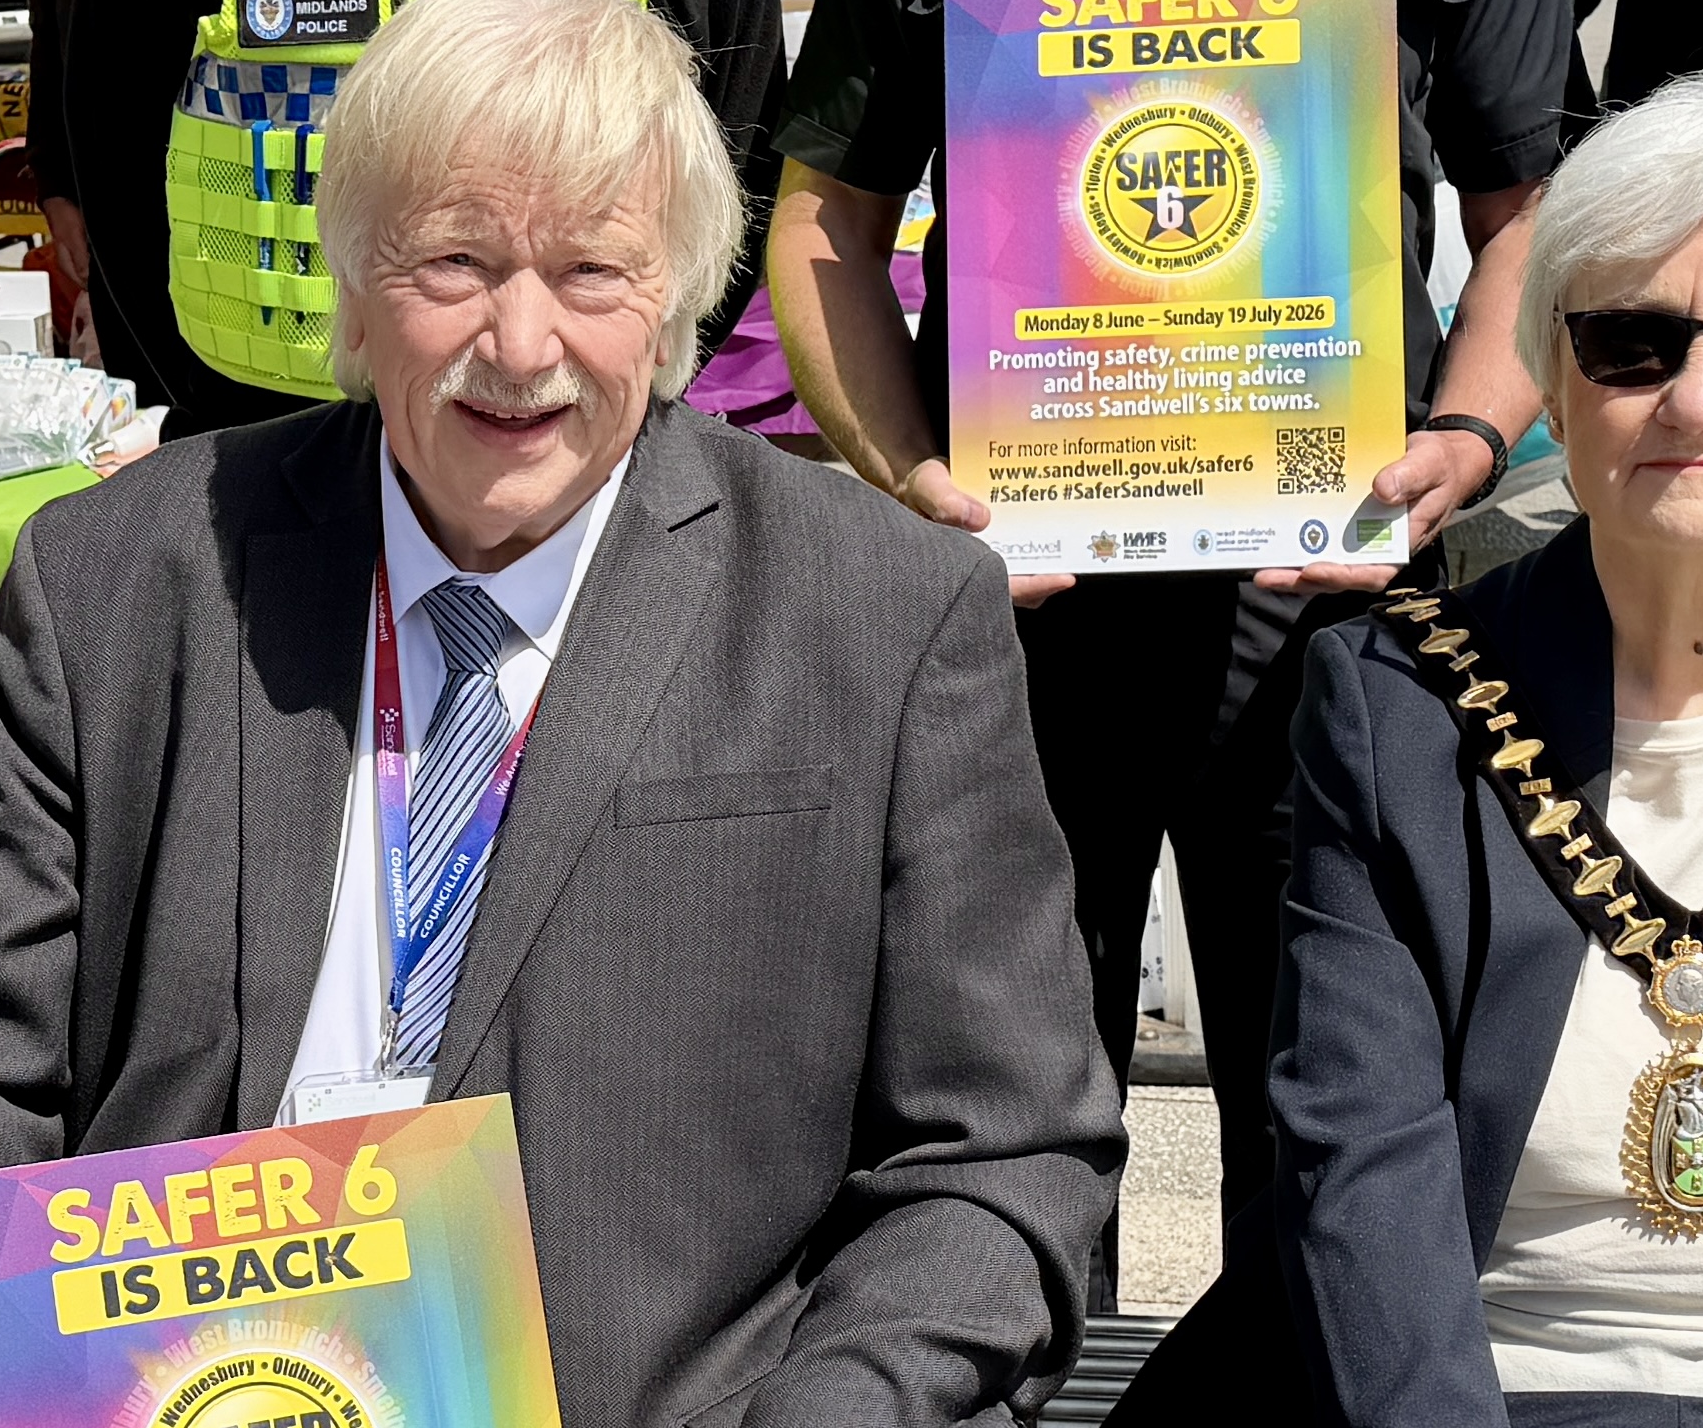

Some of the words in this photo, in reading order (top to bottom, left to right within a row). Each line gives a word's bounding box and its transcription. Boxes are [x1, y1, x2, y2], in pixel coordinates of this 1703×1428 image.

[296, 19, 348, 34] POLICE
[1072, 33, 1114, 69] IS
[1132, 26, 1265, 66] BACK
[1115, 148, 1228, 192] SAFER
[1156, 185, 1185, 230] 6
[1024, 312, 1090, 334] Monday
[1092, 312, 1104, 329] 8
[1105, 311, 1145, 329] June
[1163, 307, 1224, 329] Sunday
[1227, 306, 1247, 324] 19
[1249, 304, 1283, 326] July
[1285, 303, 1325, 322] 2026
[988, 454, 1254, 481] www.sandwell.gov.uk/safer6
[990, 484, 1058, 503] #Safer6
[1062, 478, 1204, 500] #SaferSandwell
[391, 847, 407, 939] COUNCILLOR
[419, 853, 472, 939] COUNCILLOR
[46, 1156, 322, 1264] SAFER
[344, 1143, 398, 1216] 6
[100, 1264, 160, 1319] IS
[182, 1232, 364, 1306] BACK
